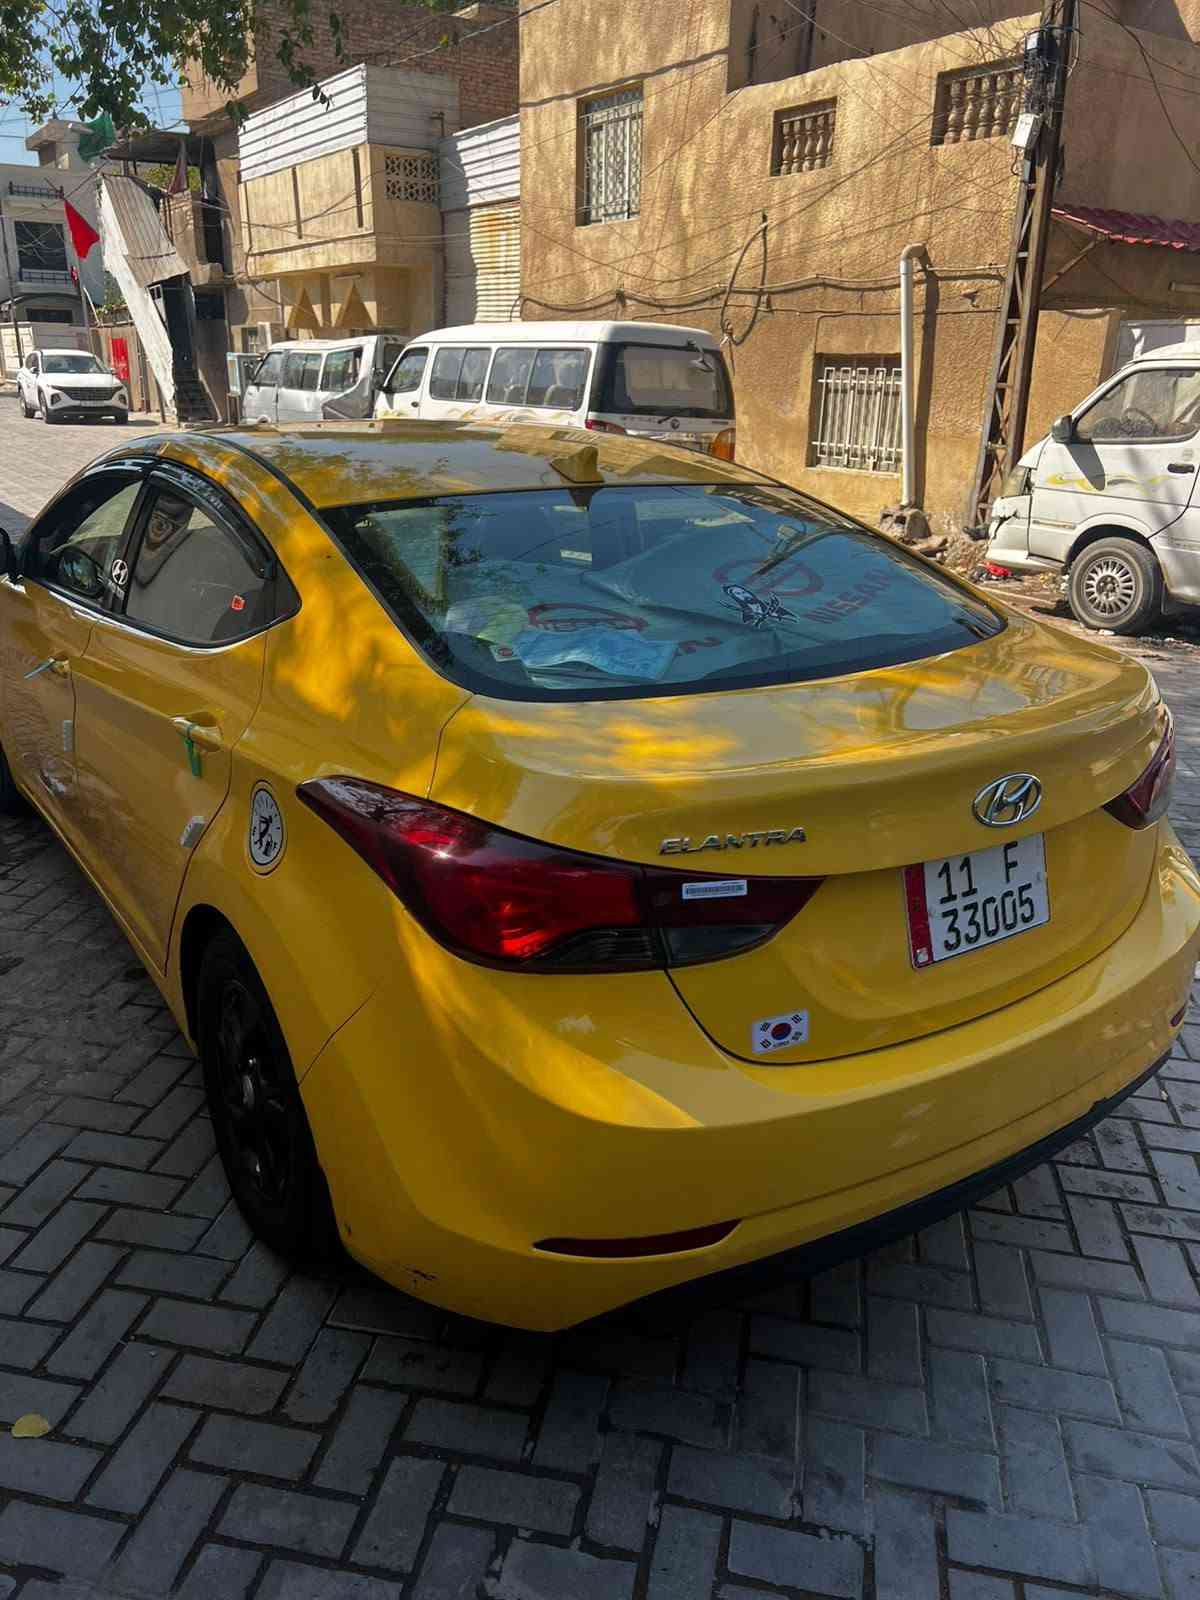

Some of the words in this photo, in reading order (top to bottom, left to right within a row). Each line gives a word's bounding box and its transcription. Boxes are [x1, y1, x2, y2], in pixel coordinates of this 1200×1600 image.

[659, 827, 807, 855] ELANTRA
[938, 856, 978, 904] 11
[1003, 841, 1018, 883] F
[941, 882, 1034, 951] 33005
